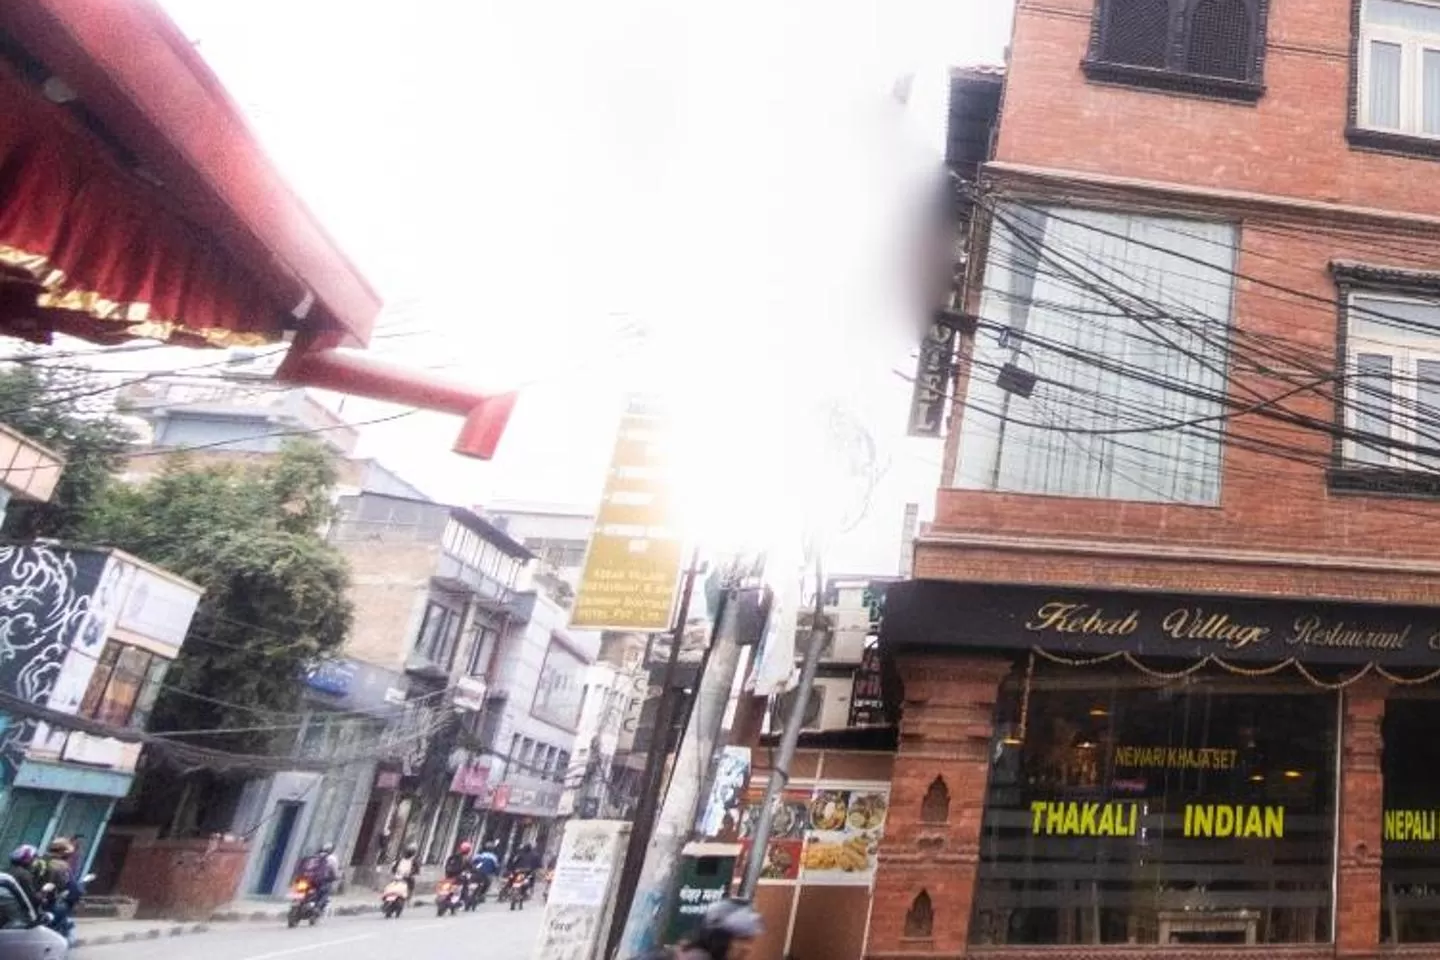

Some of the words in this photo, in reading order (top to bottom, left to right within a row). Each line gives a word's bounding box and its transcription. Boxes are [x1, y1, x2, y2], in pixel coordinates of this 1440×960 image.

[1025, 601, 1141, 636] Kebab
[1162, 607, 1271, 649] Village
[1115, 746, 1165, 768] NEWARI
[1212, 748, 1238, 770] SET
[1030, 800, 1138, 837] THAKALI
[1183, 803, 1285, 838] INDIAN
[1384, 809, 1436, 841] NEPALI
